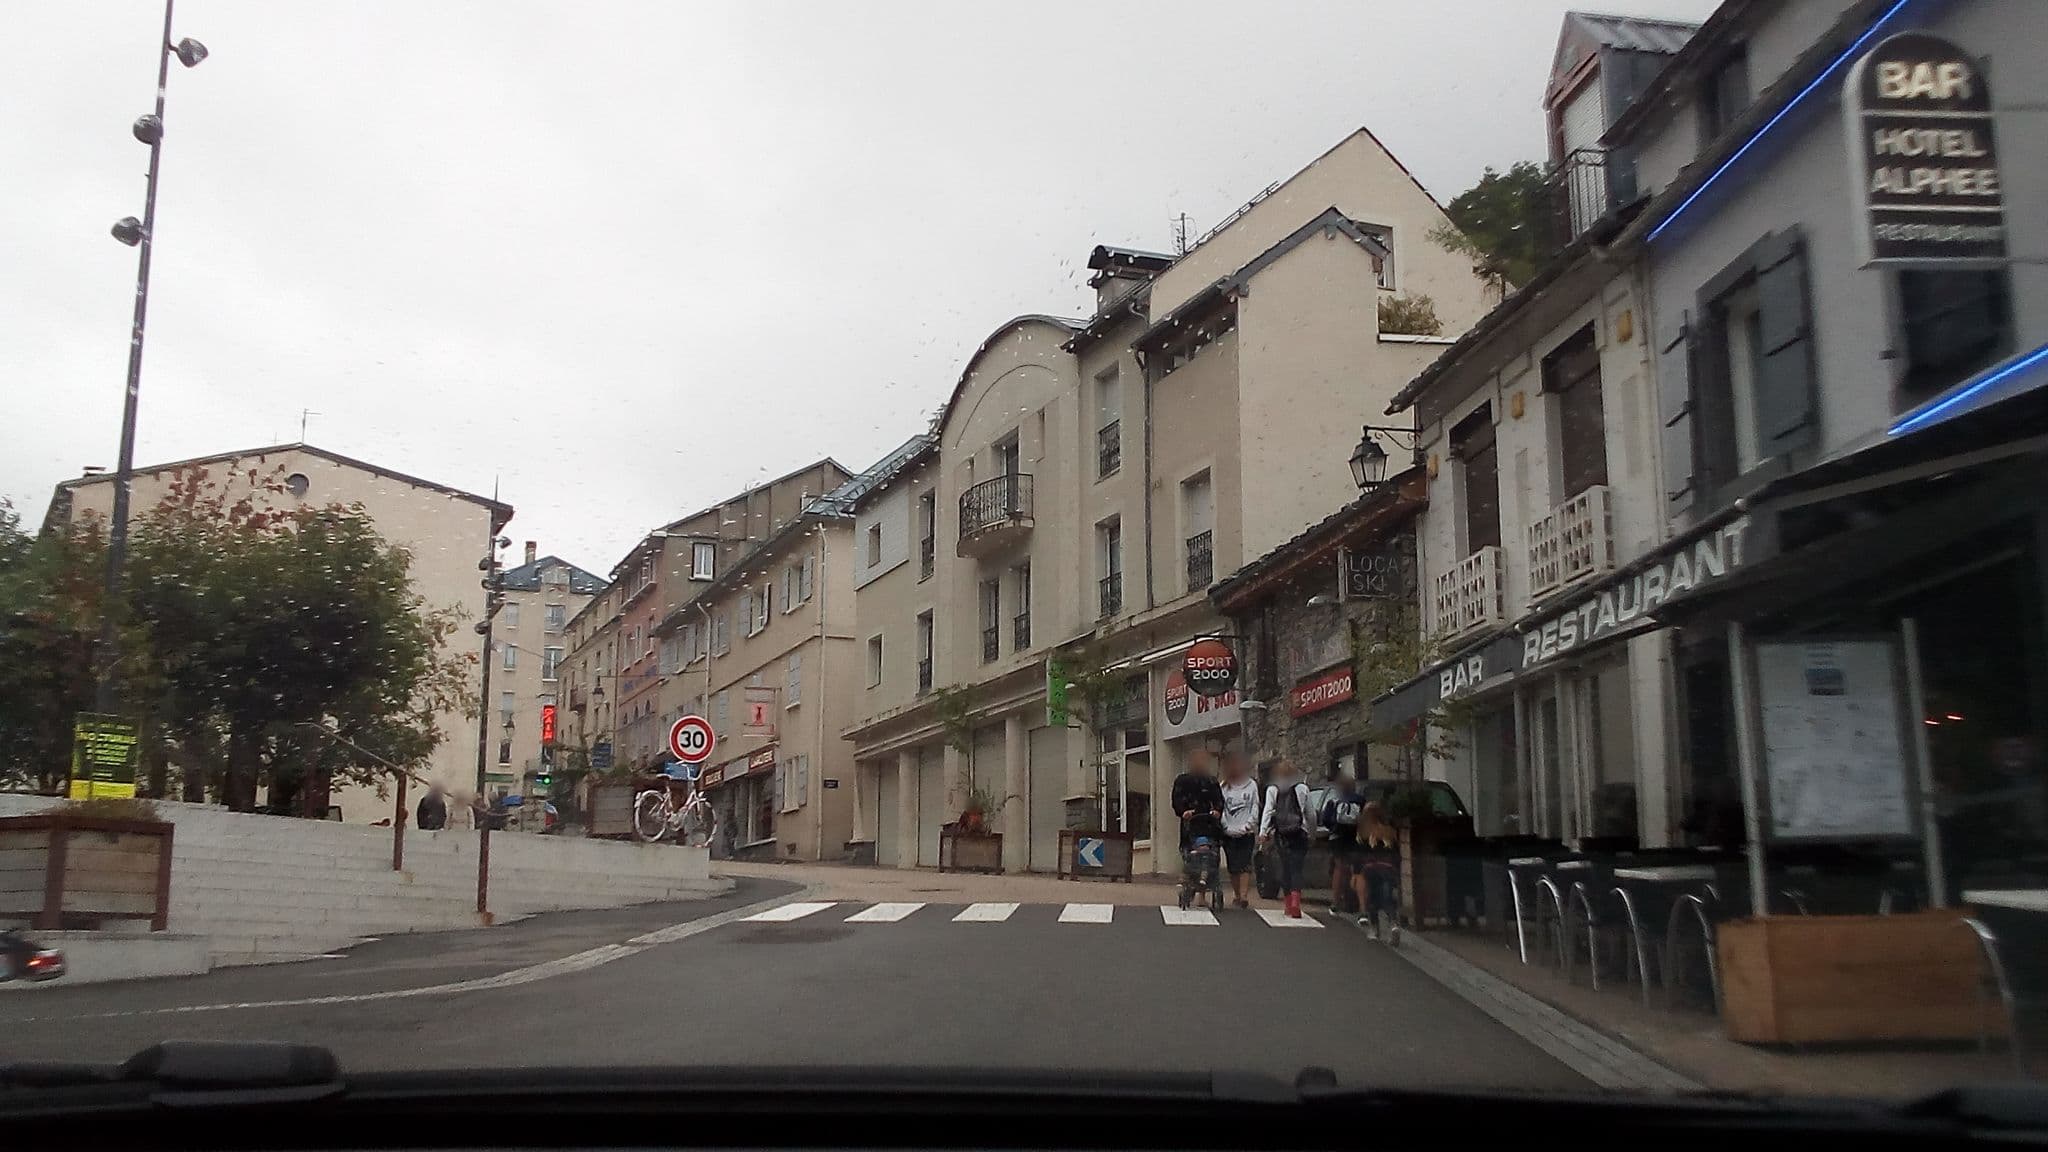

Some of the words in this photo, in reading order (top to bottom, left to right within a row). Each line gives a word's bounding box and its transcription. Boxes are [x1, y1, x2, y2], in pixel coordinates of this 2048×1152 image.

[1877, 61, 1971, 99] BAR
[1873, 128, 1987, 156] HOTEL
[1872, 166, 2000, 195] ALPHEE
[1350, 555, 1399, 573] LOCA
[1440, 655, 1483, 699] BAR
[1522, 519, 1749, 667] RESTAURANT
[1187, 657, 1232, 668] SPORT
[1192, 669, 1230, 680] 2000
[679, 730, 705, 749] 30
